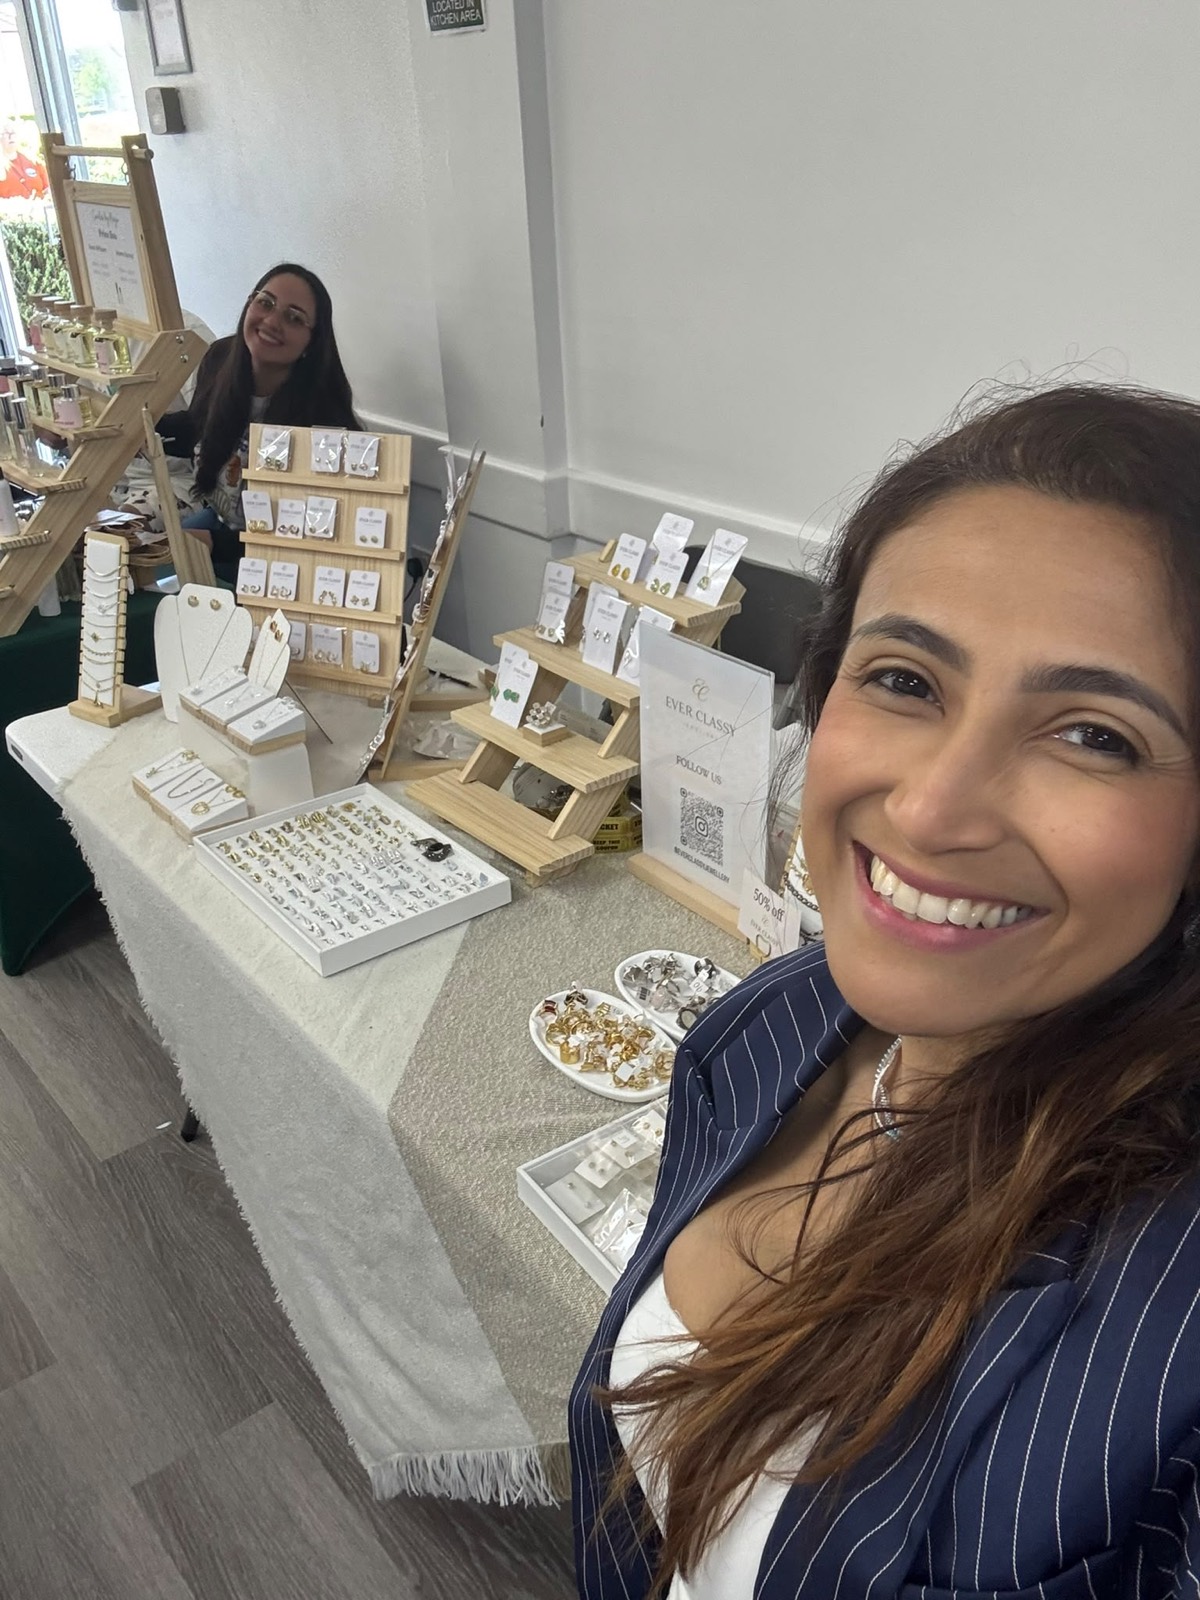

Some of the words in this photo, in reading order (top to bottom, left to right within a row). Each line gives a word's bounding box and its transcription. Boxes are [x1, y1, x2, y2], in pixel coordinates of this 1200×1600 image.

[430, 12, 459, 26] KITCHEN
[460, 9, 482, 22] AREA
[432, 0, 465, 13] LOCATED
[665, 695, 693, 718] EVER
[695, 710, 735, 737] CLASSY
[676, 755, 710, 779] FOLLOW
[711, 772, 723, 786] US
[753, 887, 771, 912] 50%
[771, 907, 786, 922] off
